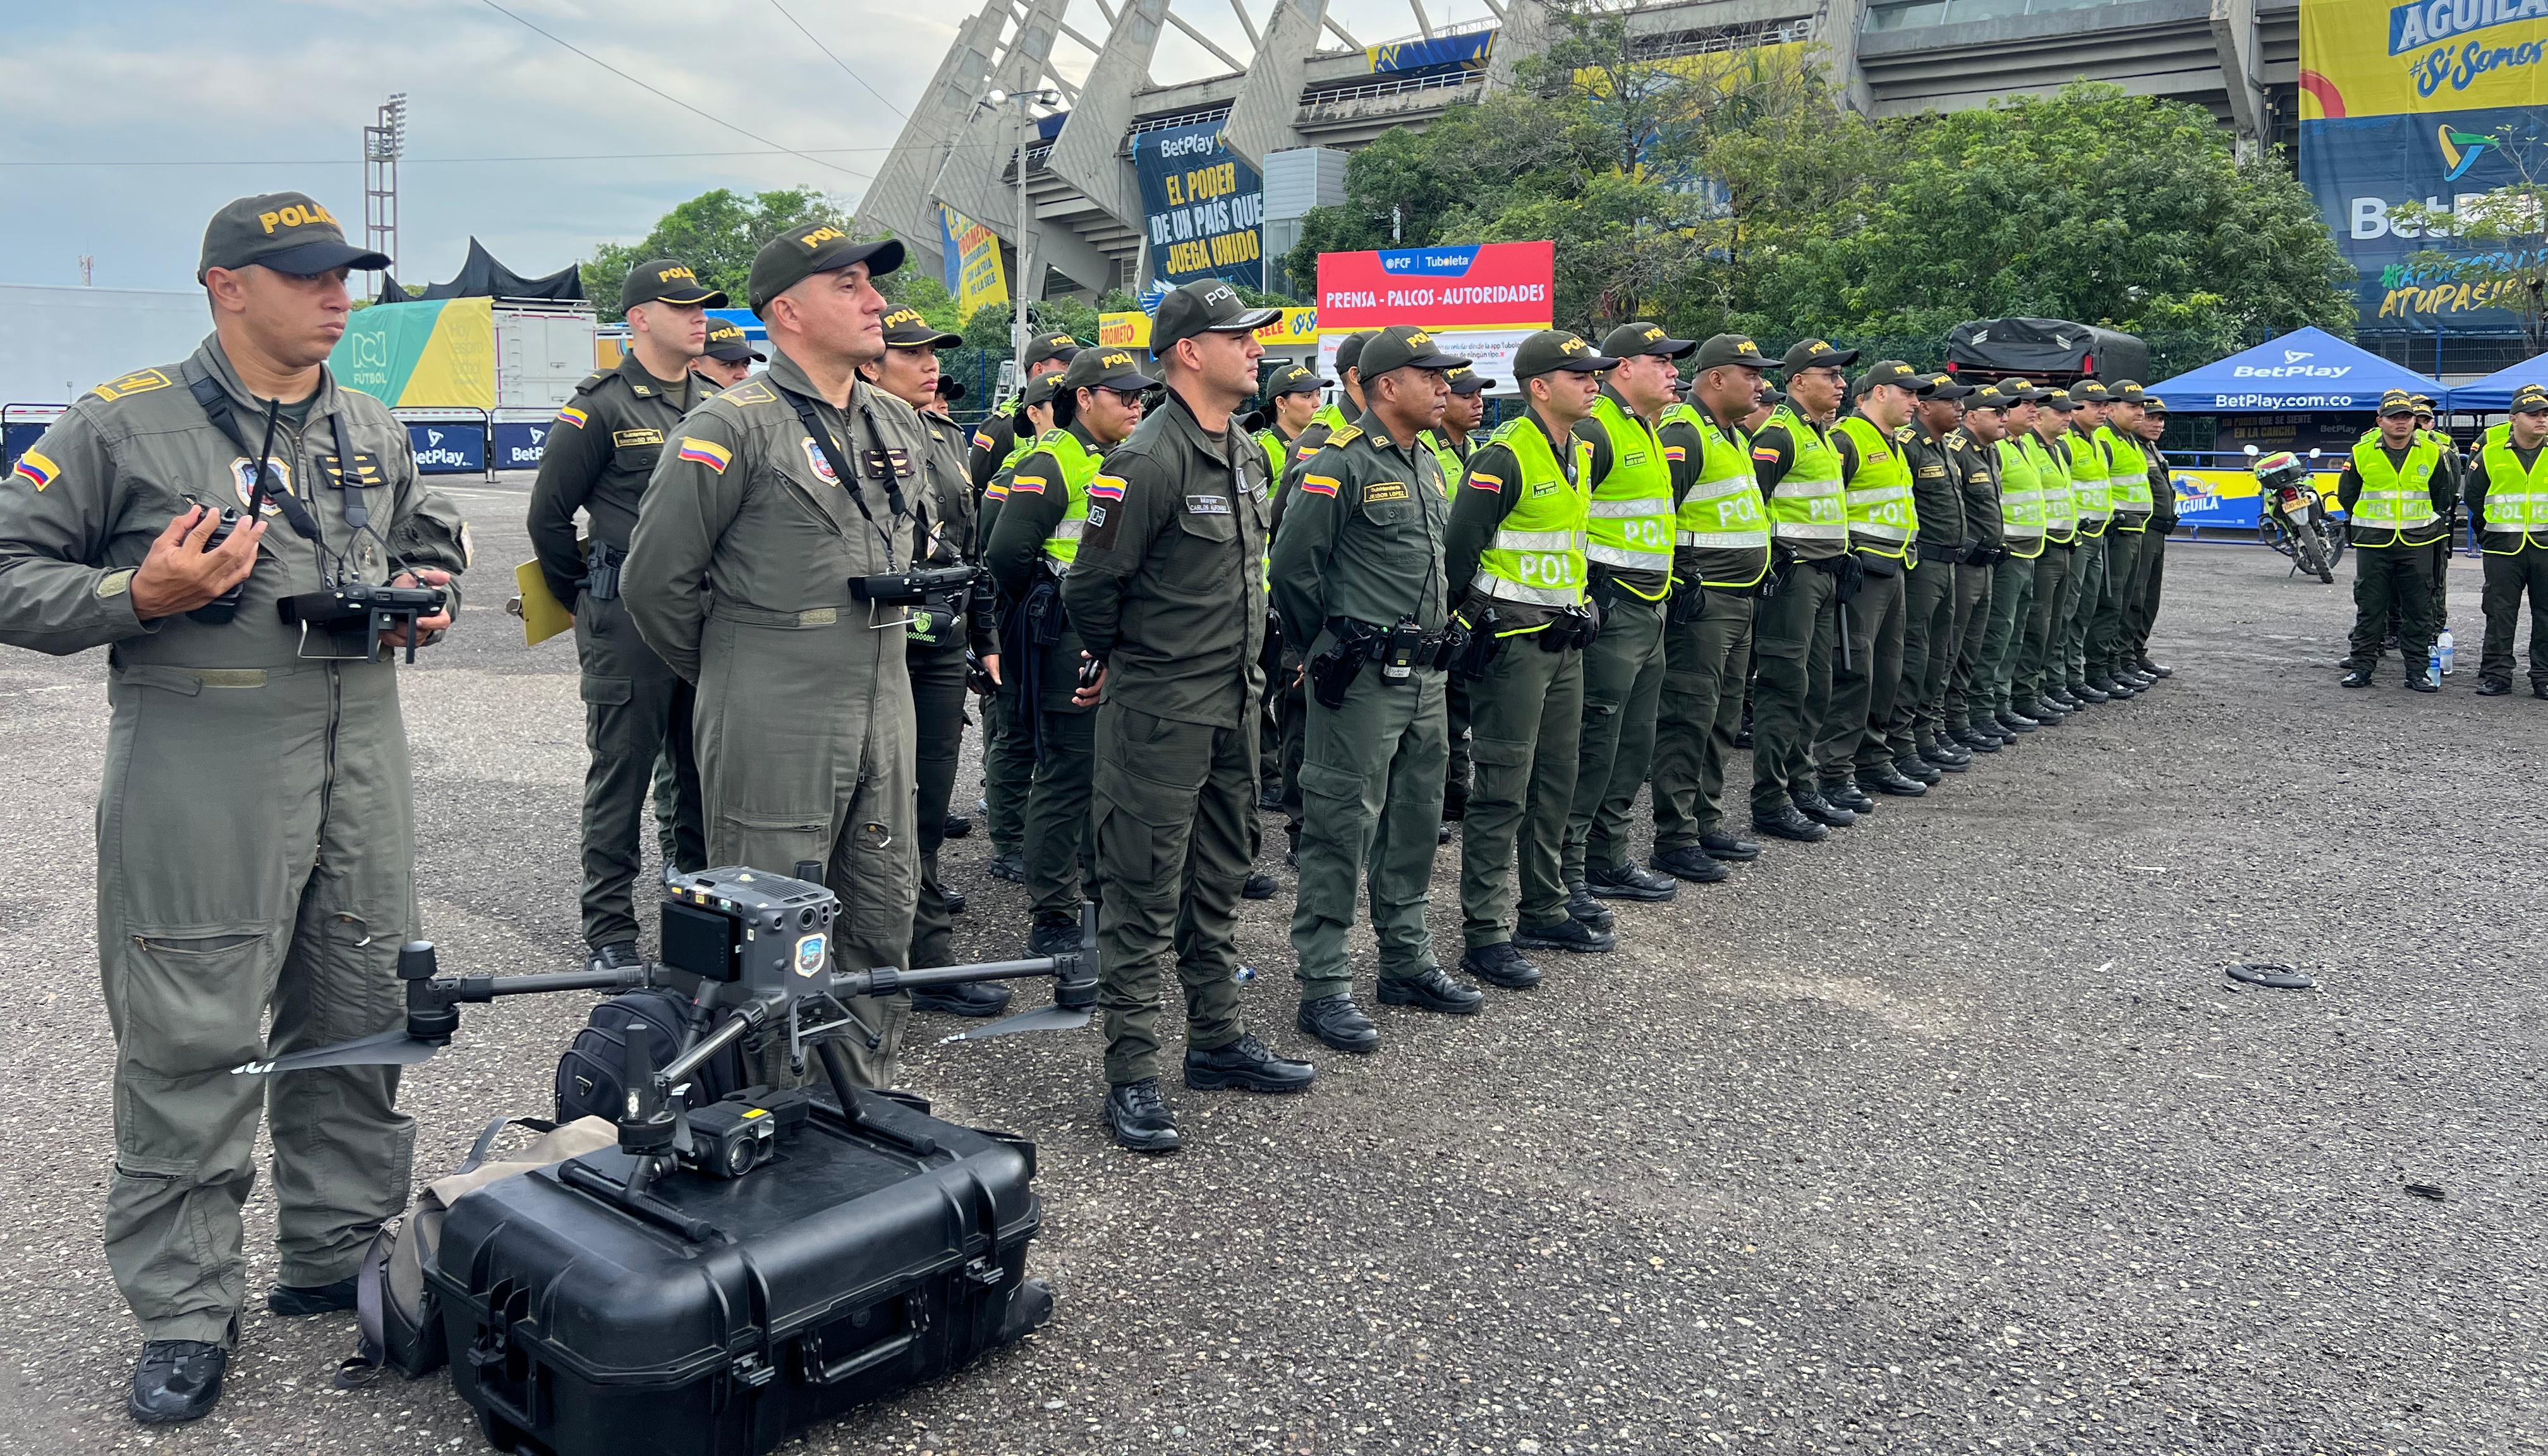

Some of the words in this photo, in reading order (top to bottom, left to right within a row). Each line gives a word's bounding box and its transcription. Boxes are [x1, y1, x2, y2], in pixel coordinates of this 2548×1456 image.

[1160, 133, 1215, 158] BetPlay
[1166, 174, 1186, 206] EL
[1187, 162, 1236, 202] PODER
[1151, 213, 1173, 245] DE
[1172, 209, 1194, 240] UN
[1194, 195, 1230, 236] PAÍS
[1231, 192, 1263, 230] QUE
[1166, 239, 1211, 275] JUEGA
[1211, 229, 1260, 267] UNIDO
[974, 265, 981, 277] LA
[1394, 257, 1411, 269] FCF
[1425, 255, 1469, 267] Tuboleta
[978, 282, 985, 292] LA
[984, 272, 997, 289] SELE
[1326, 291, 1376, 308] PRENSA
[1387, 289, 1435, 306] PALCOS
[1101, 323, 1135, 346] PROMETO
[1258, 320, 1284, 339] SELE
[353, 370, 387, 385] FÚTBOL
[2233, 365, 2353, 379] BetPlay
[2216, 394, 2352, 410] BetPlay.com.co
[2234, 416, 2258, 427] PODER
[2259, 415, 2273, 425] QUE
[2275, 415, 2284, 425] SE
[2286, 414, 2312, 424] SIENTE
[2320, 424, 2357, 434] BetPlay
[2234, 427, 2245, 439] EN
[2247, 427, 2259, 438] LA
[2260, 425, 2297, 437] CANCHA
[2175, 497, 2219, 515] AGUILA
[2492, 506, 2524, 520] POL
[1624, 519, 1671, 547] POL
[1519, 554, 1575, 585] POL
